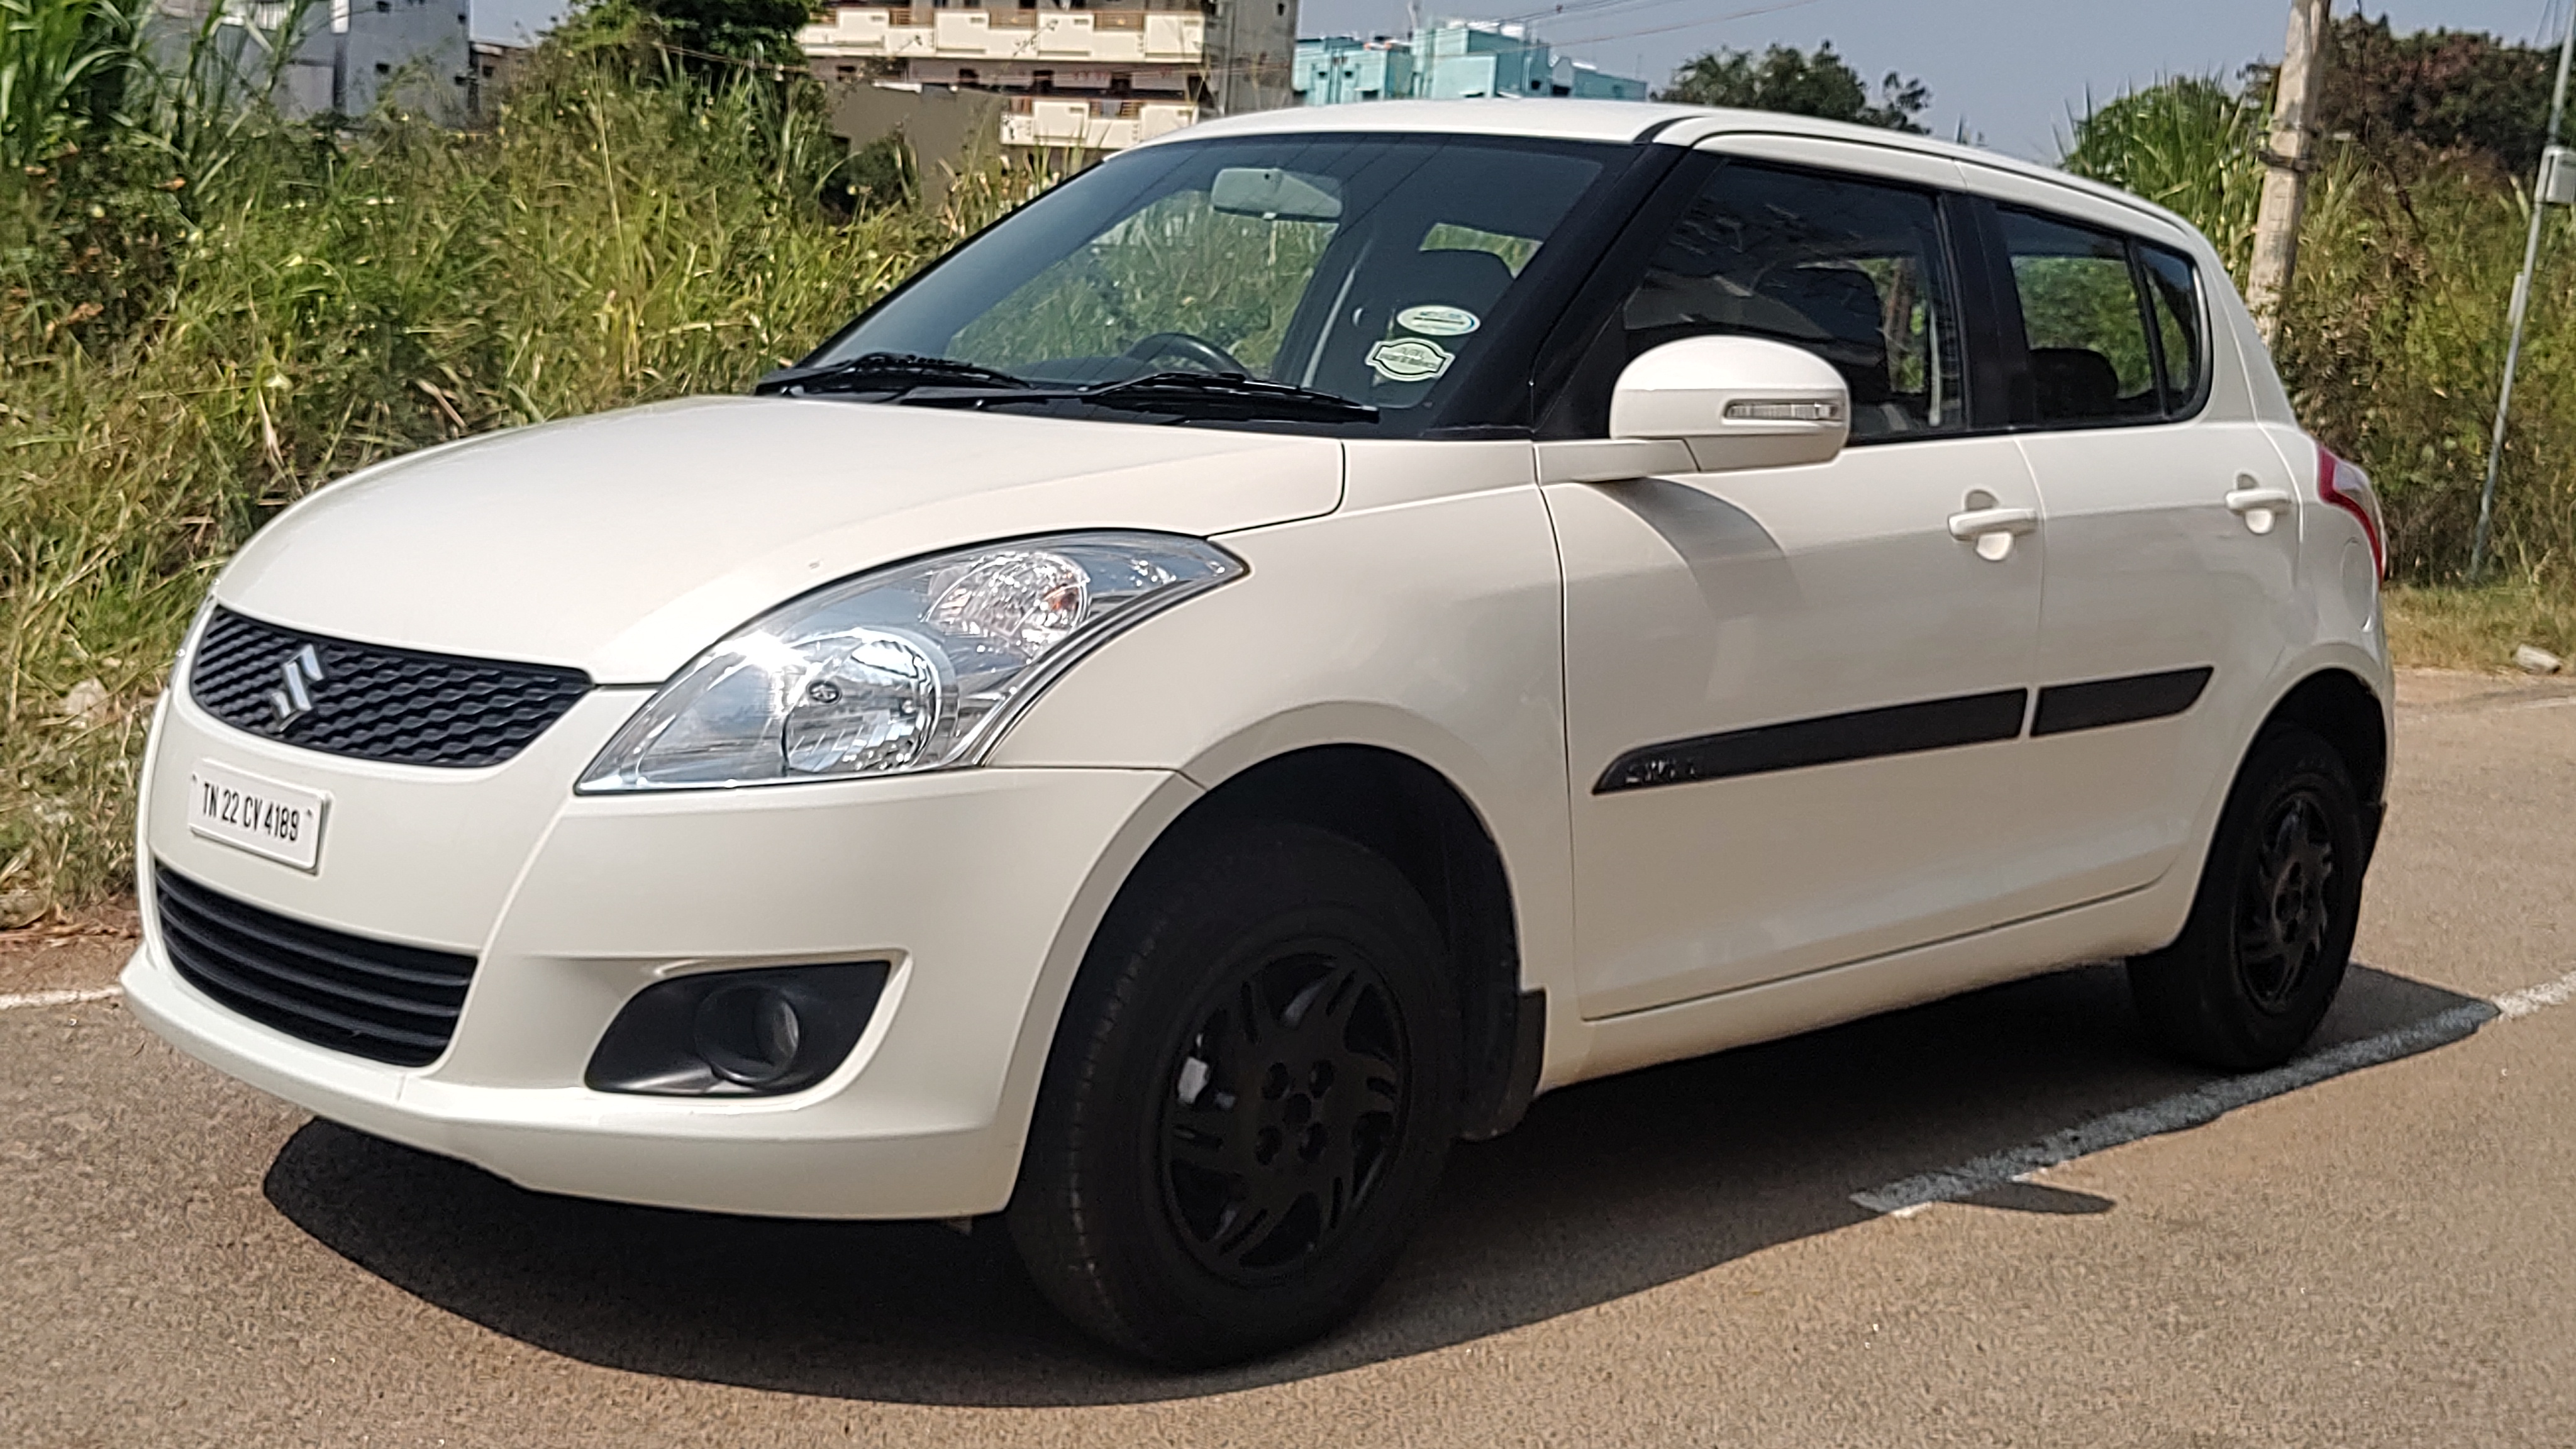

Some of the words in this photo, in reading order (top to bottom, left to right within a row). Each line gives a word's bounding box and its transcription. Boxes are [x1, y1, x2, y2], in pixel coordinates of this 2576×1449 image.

[204, 782, 219, 818] TN
[222, 789, 240, 824] 22
[264, 801, 300, 841] 4189
